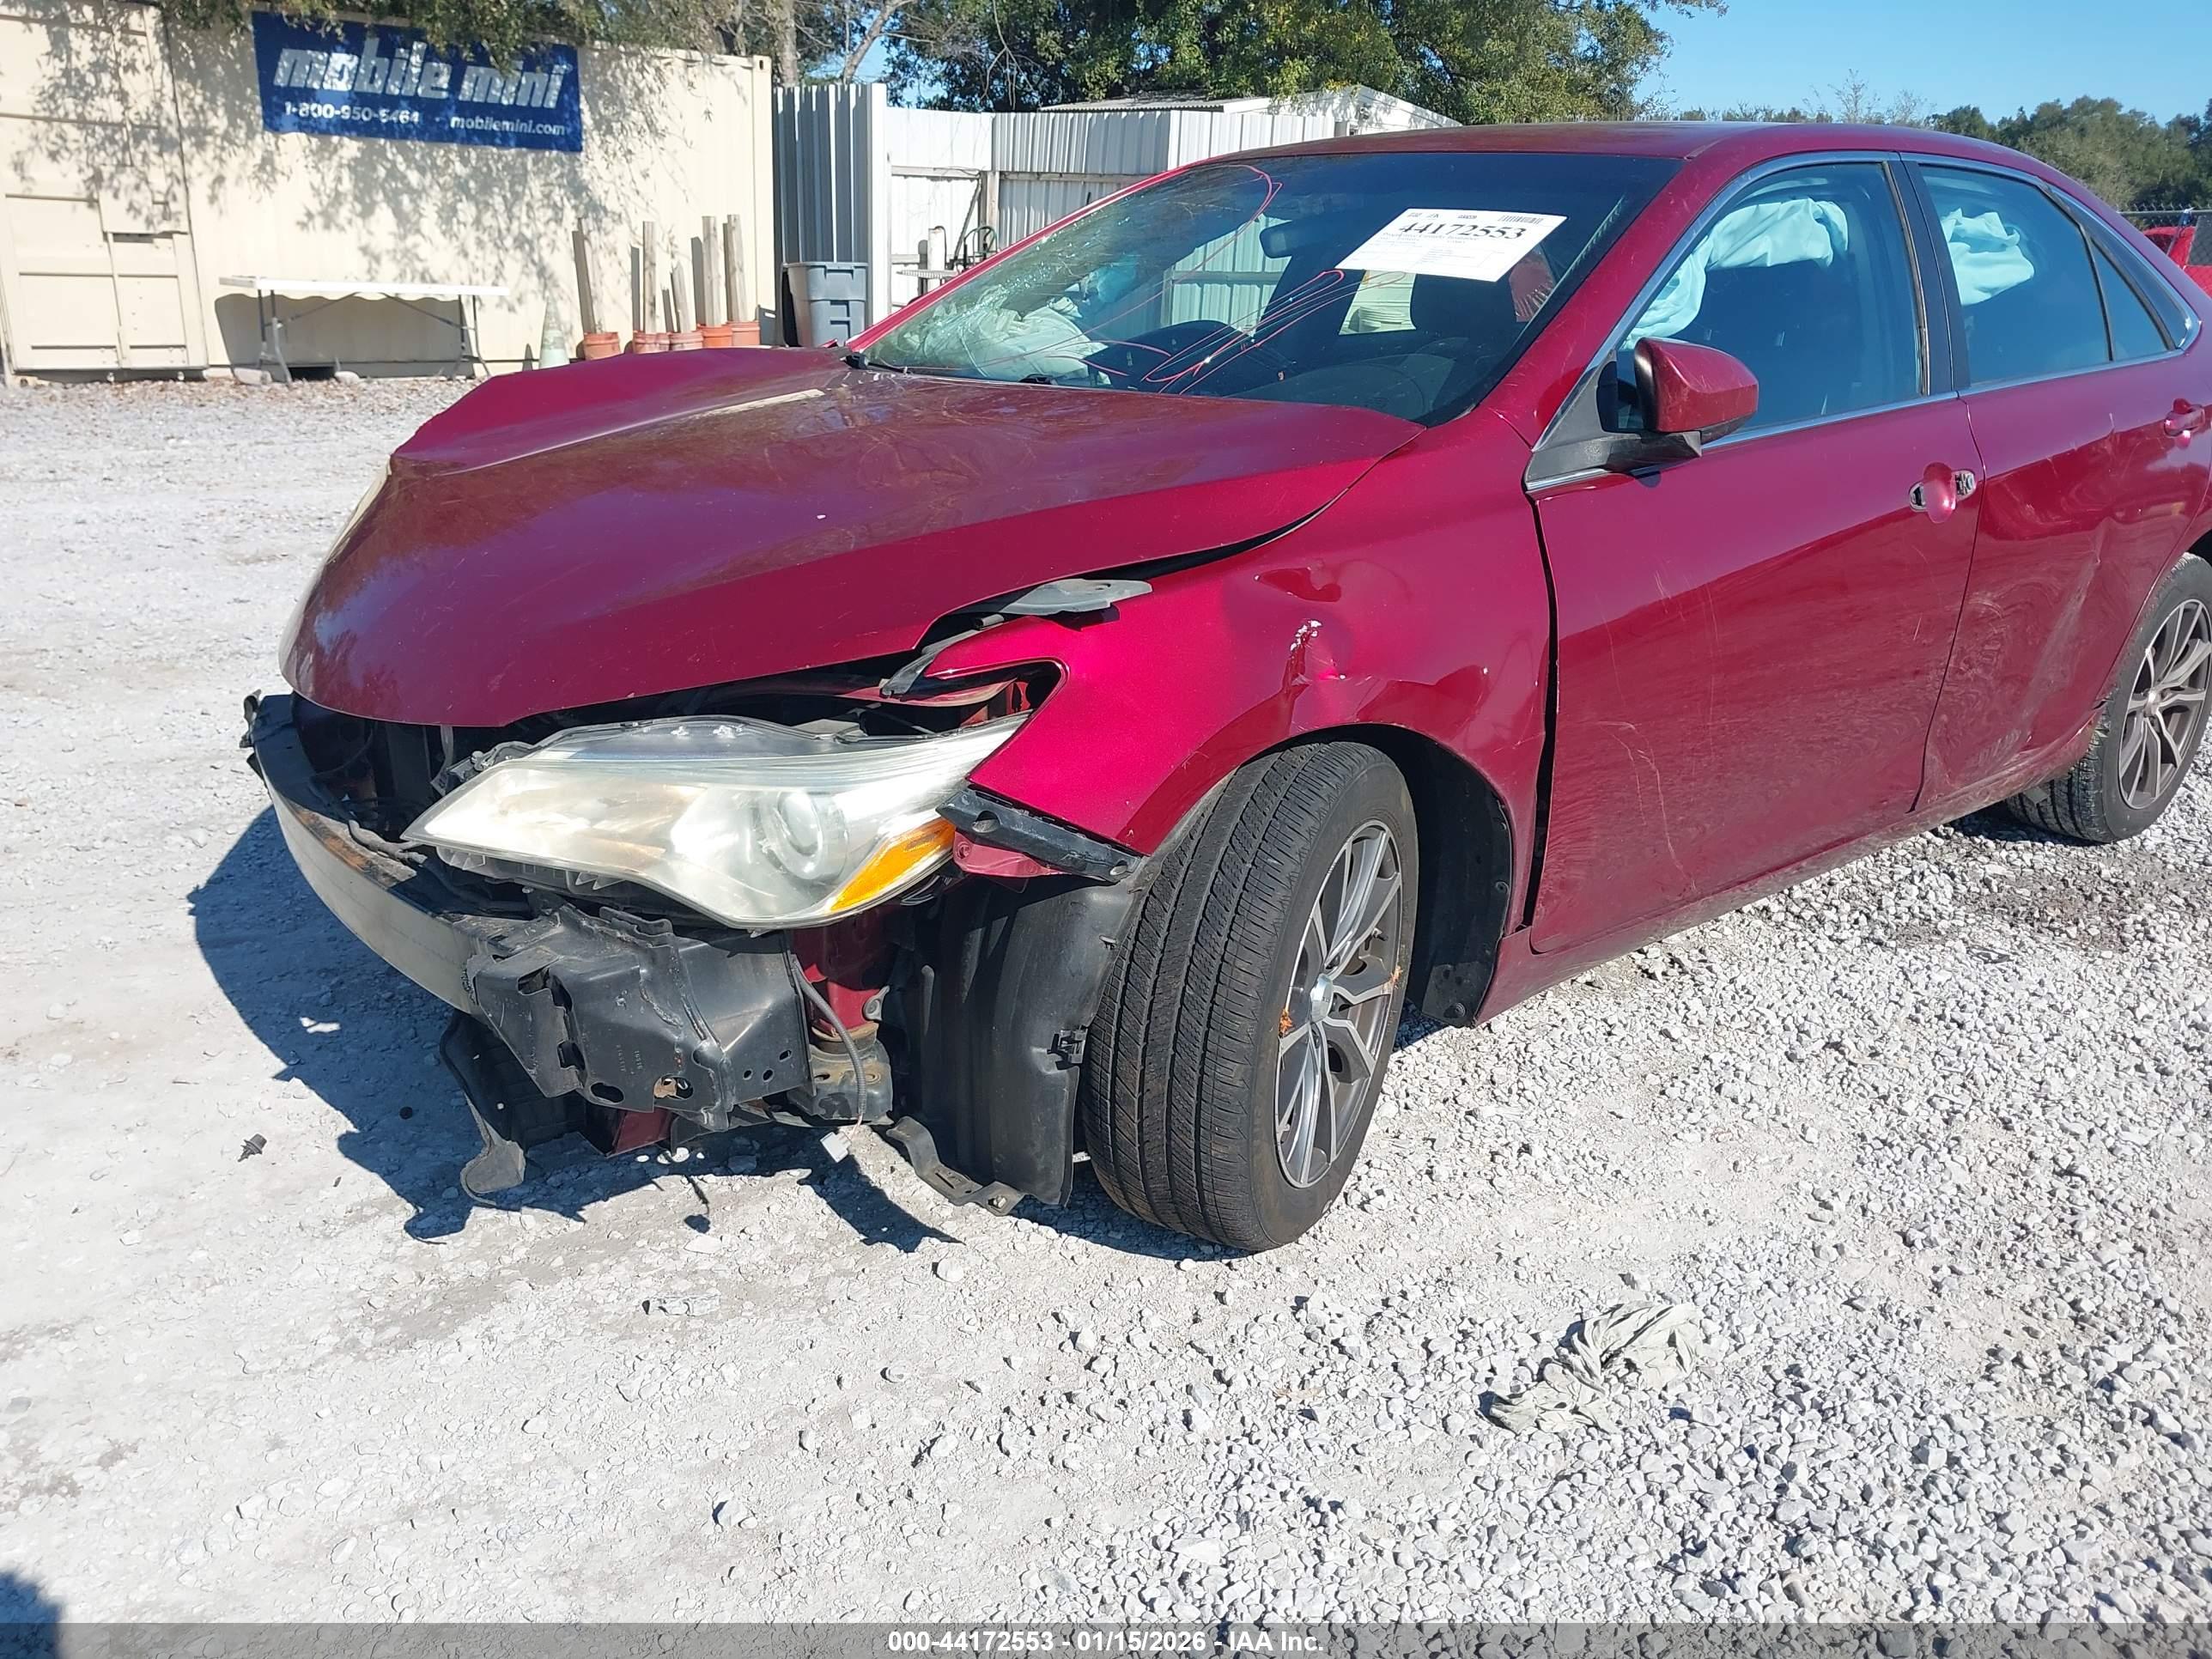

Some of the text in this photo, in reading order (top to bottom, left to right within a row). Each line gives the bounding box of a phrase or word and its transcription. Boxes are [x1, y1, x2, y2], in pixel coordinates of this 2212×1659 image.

[273, 36, 567, 109] mobile mini
[283, 100, 567, 136] 1-800-950-5464 mobilemini.com
[1399, 222, 1528, 240] 44172553
